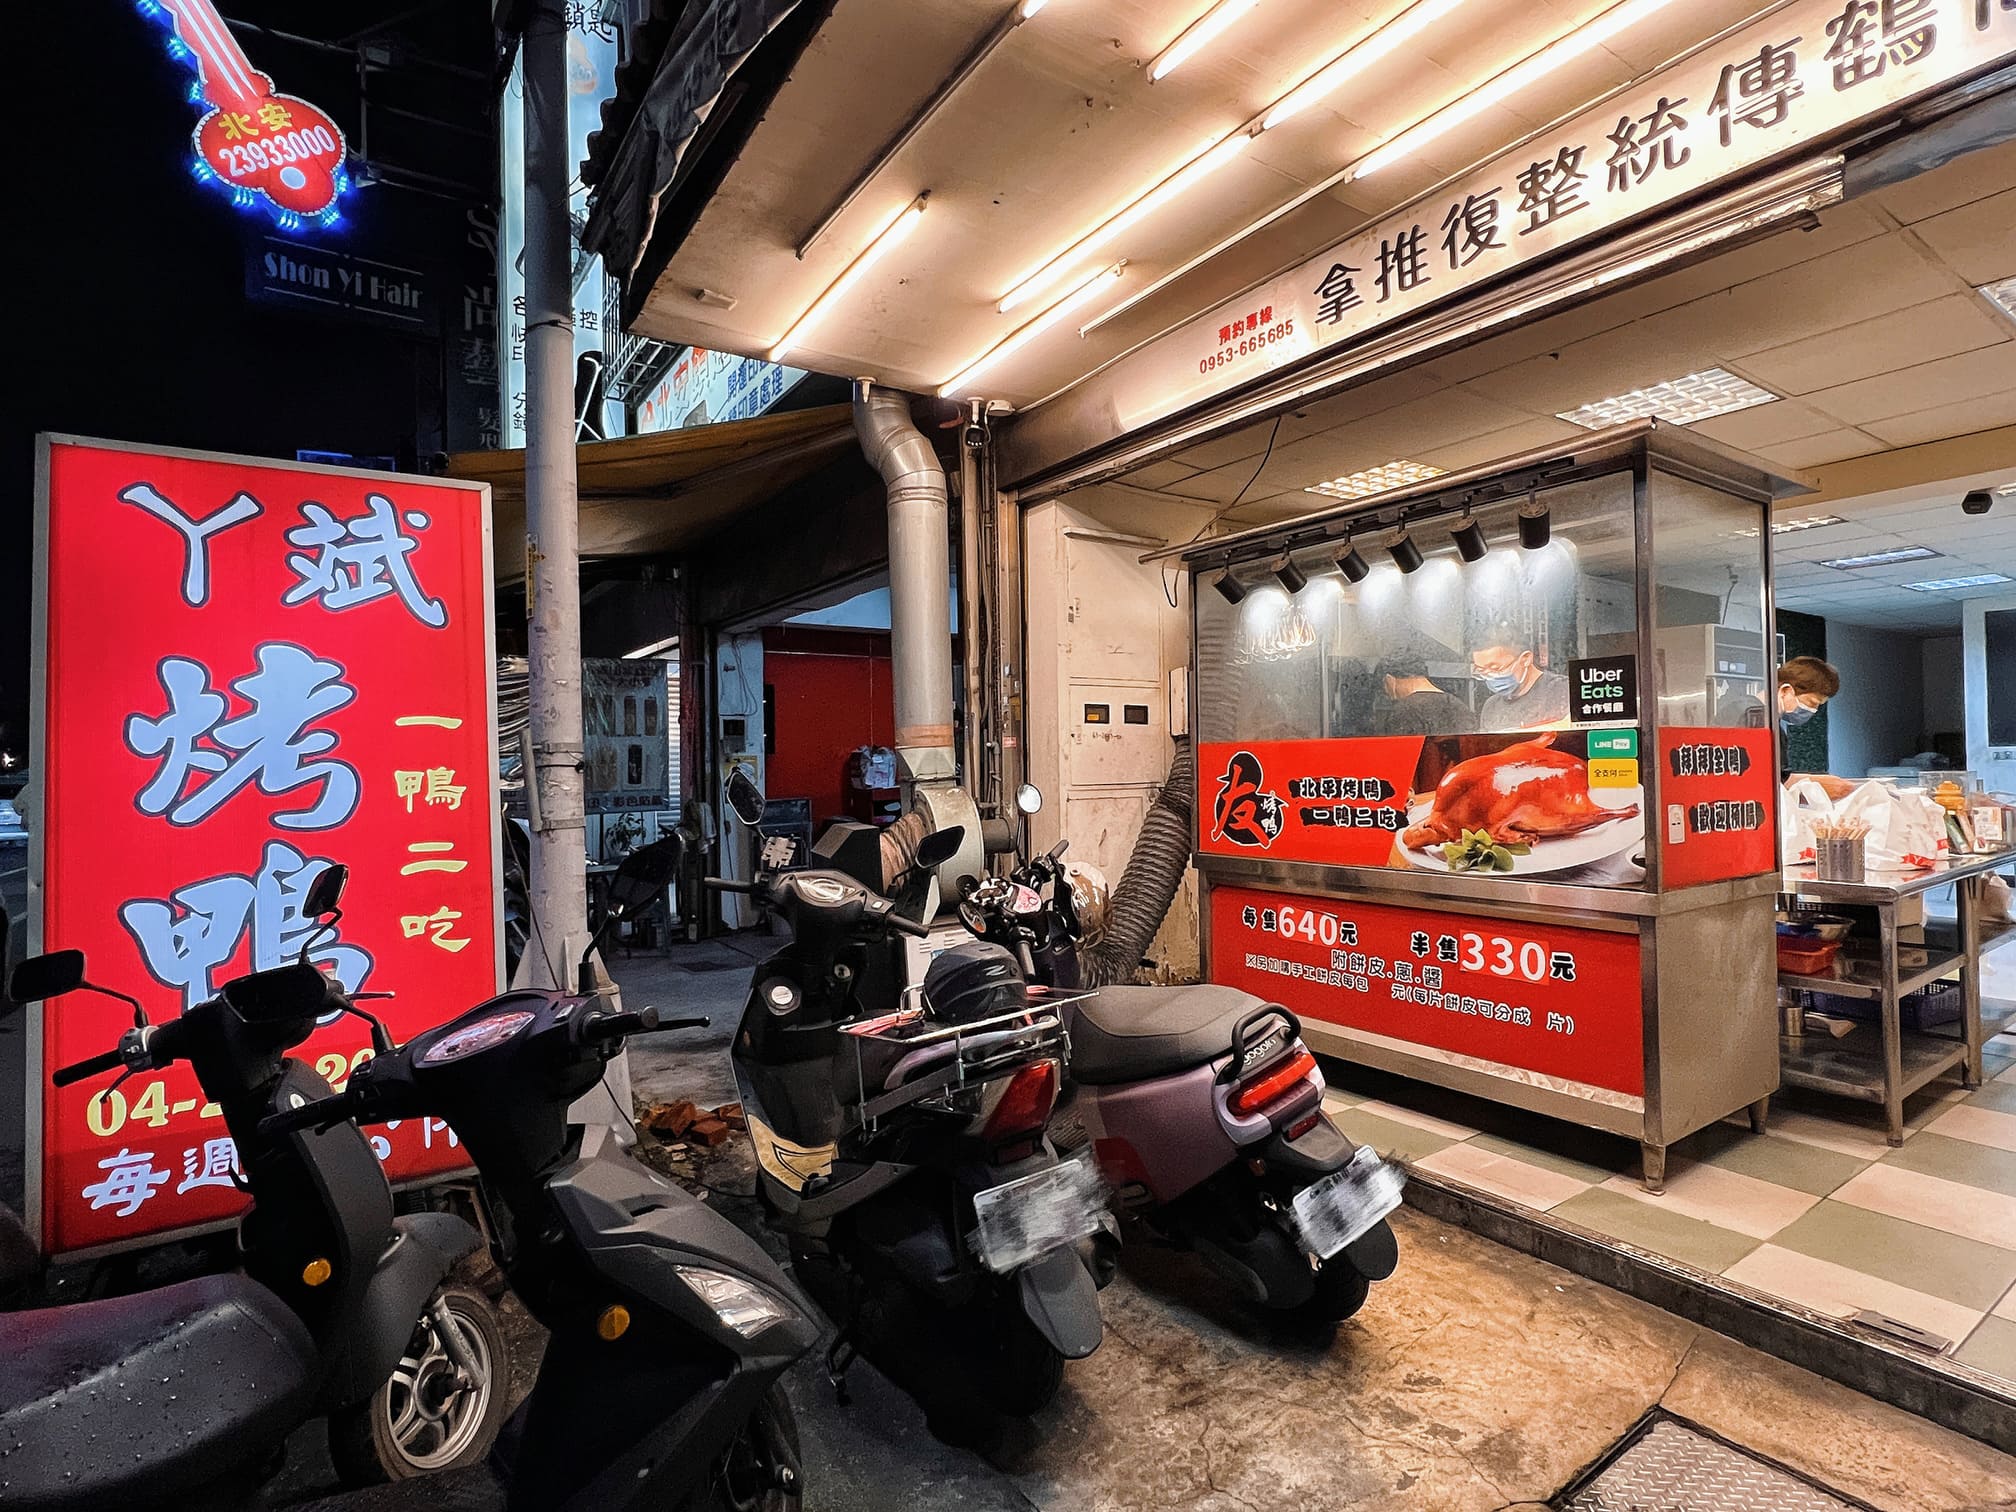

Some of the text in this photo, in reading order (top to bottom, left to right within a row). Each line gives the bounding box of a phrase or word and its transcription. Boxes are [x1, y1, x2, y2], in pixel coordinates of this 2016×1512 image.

[218, 103, 292, 140] 北安
[219, 125, 336, 177] 23933000
[264, 252, 423, 309] Shon Yi Hair
[1199, 319, 1293, 374] 0953-665685
[1580, 668, 1623, 683] Uber
[1581, 684, 1624, 700] Eats
[1299, 777, 1382, 801] 北平烤鴨
[395, 716, 471, 953] 一鴨二吃
[1311, 805, 1397, 829] 一鴨二吃
